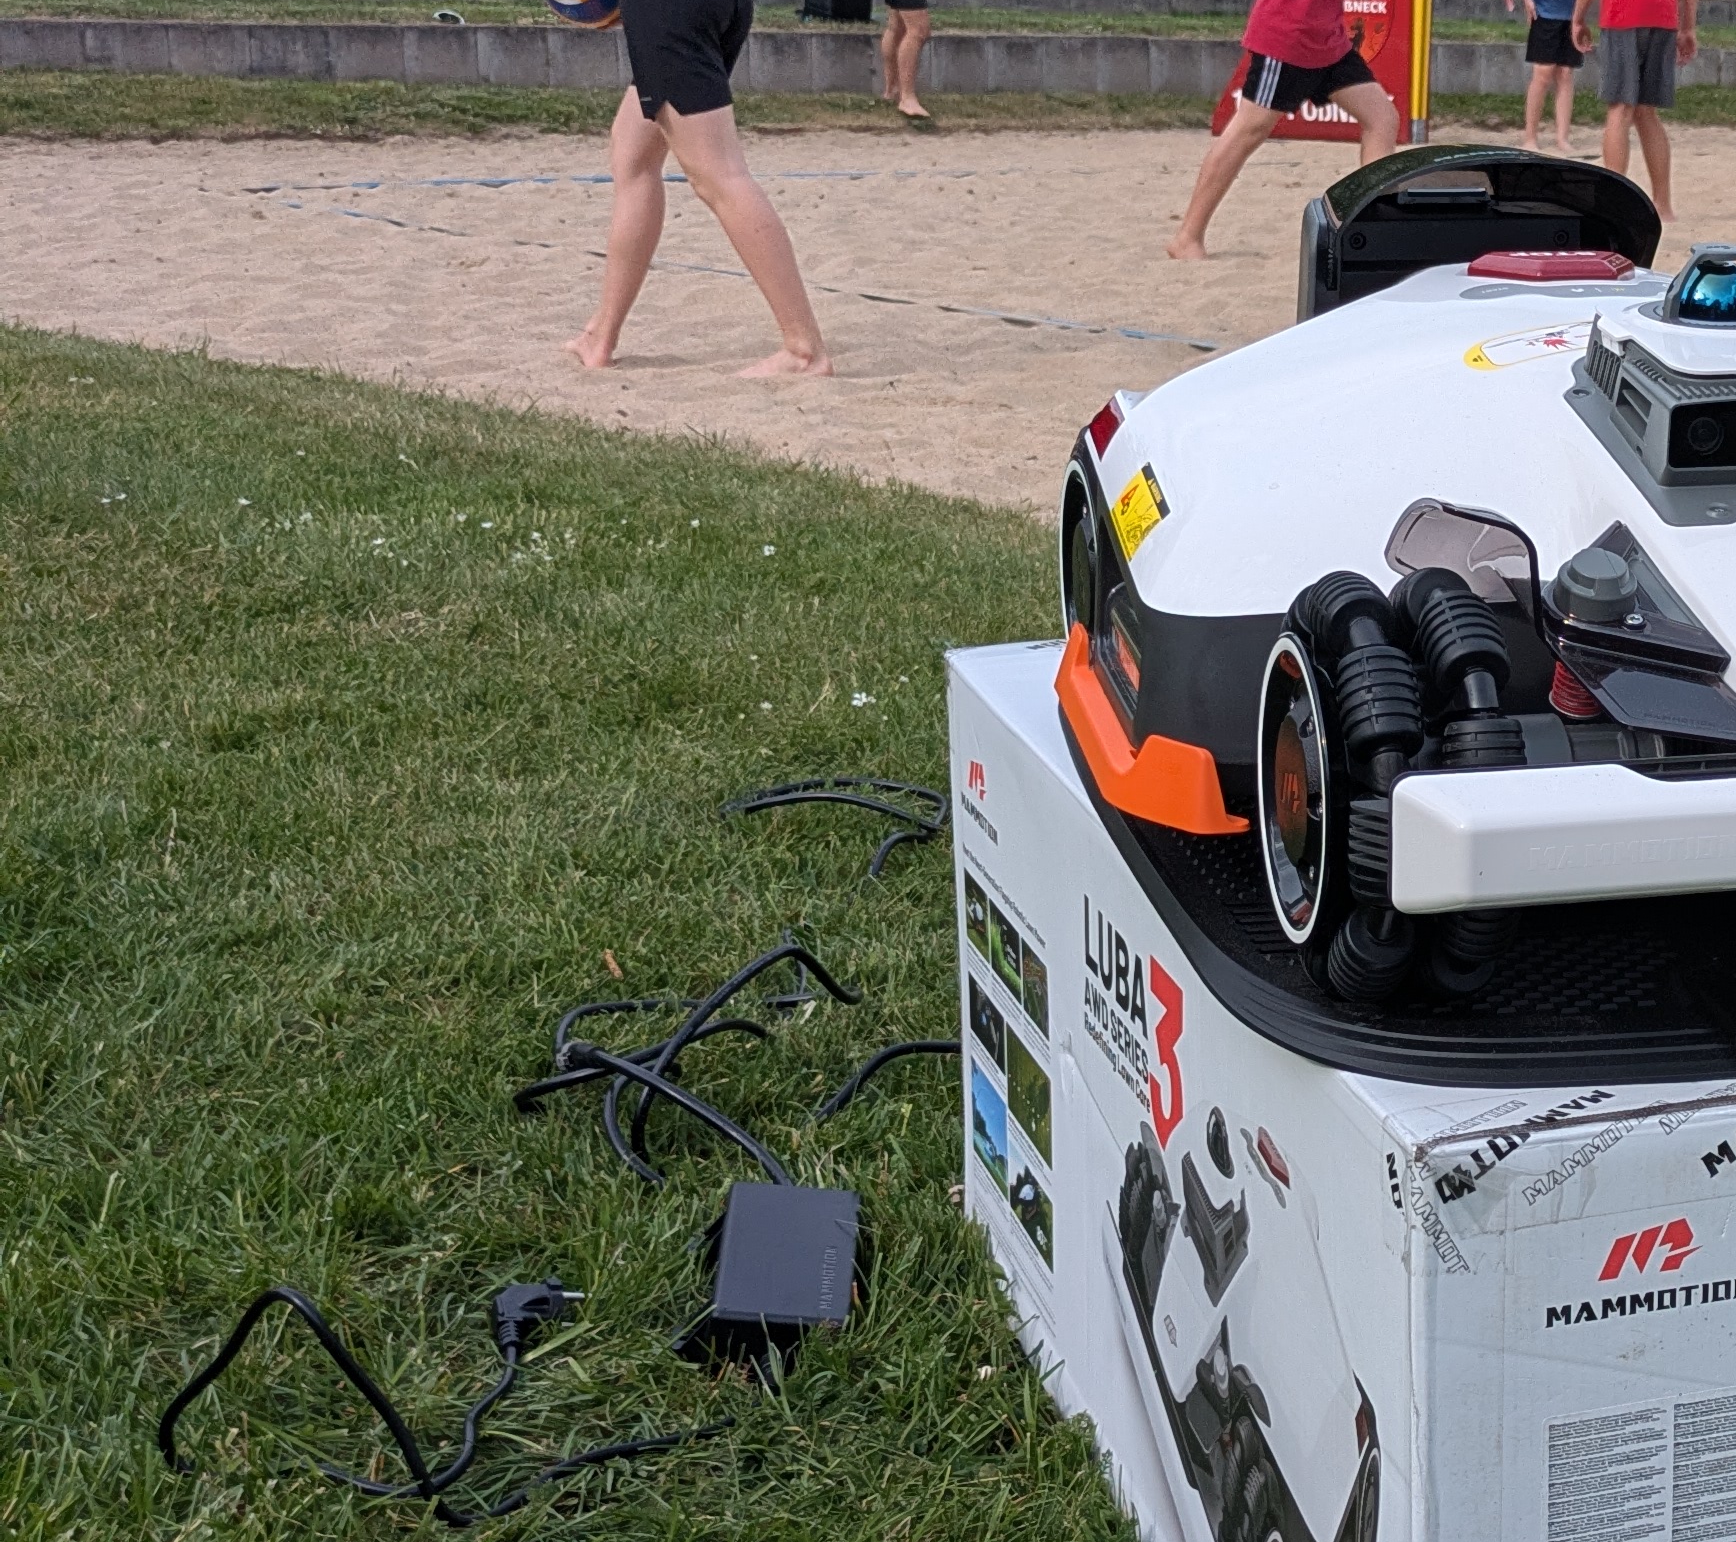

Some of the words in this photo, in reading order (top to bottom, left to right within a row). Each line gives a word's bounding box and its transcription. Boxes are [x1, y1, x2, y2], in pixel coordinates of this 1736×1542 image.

[1084, 893, 1148, 1041] LUBA
[1150, 954, 1183, 1151] 3
[1084, 976, 1108, 1031] AWD
[1111, 1009, 1148, 1084] SERIES
[1084, 1011, 1116, 1072] Redefining
[1117, 1054, 1134, 1093] Lawn
[1136, 1078, 1150, 1114] Care
